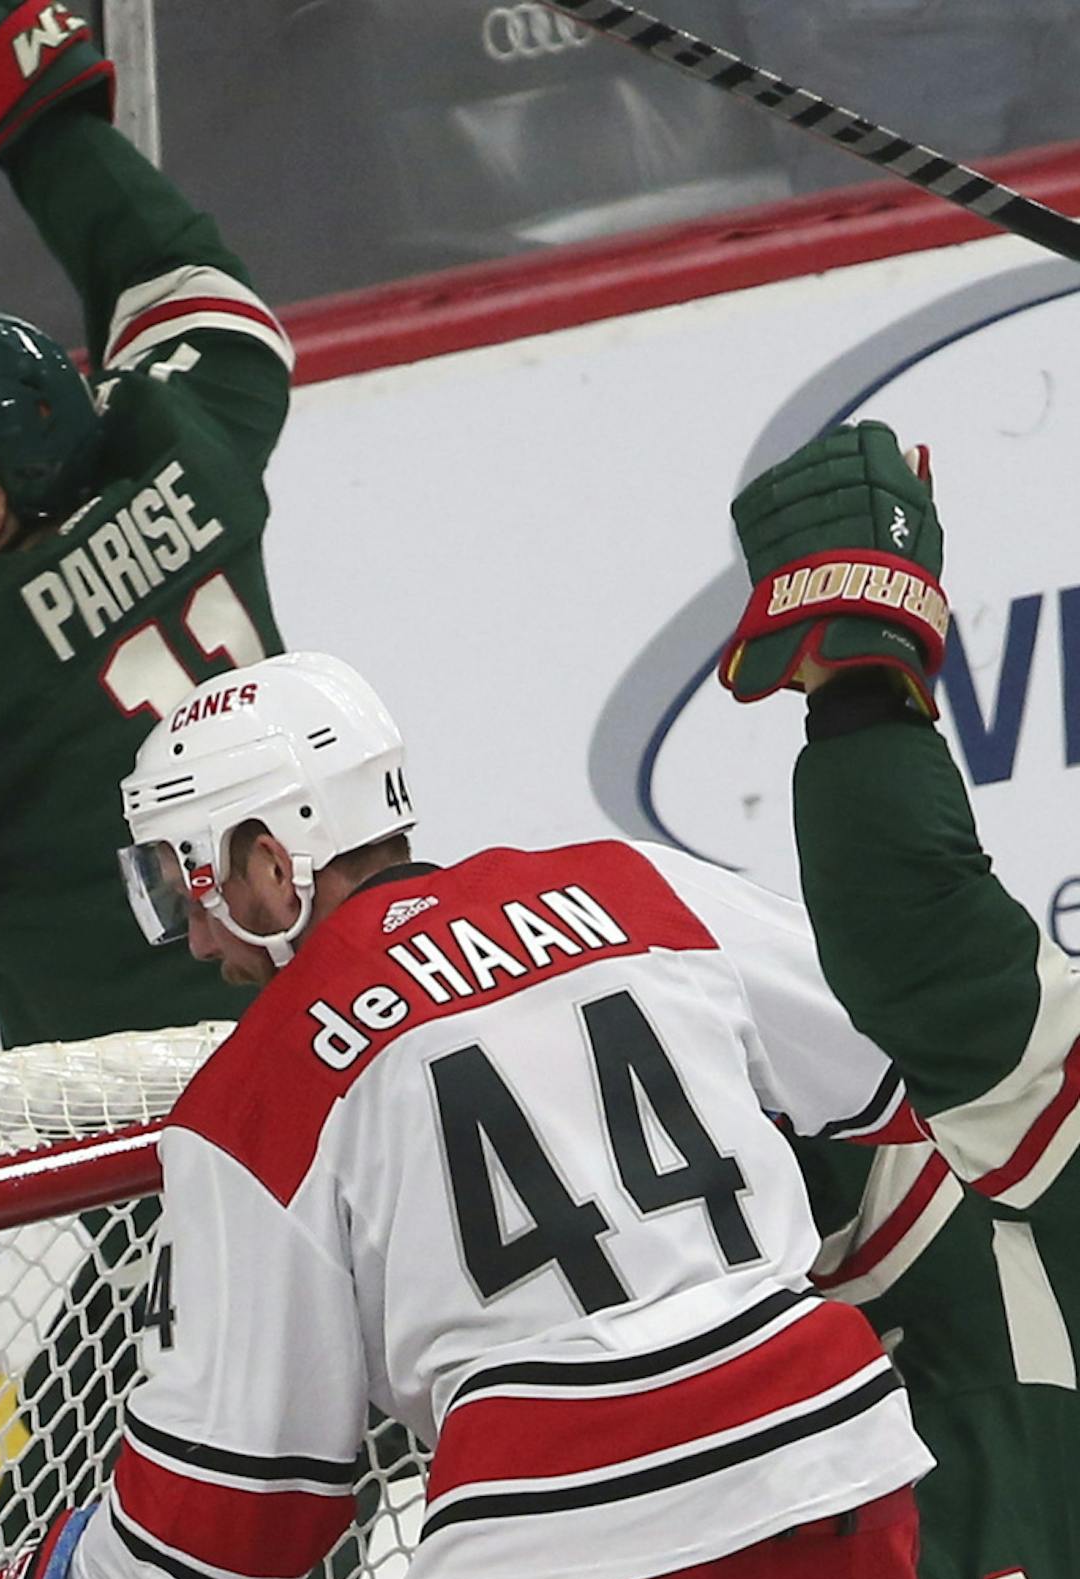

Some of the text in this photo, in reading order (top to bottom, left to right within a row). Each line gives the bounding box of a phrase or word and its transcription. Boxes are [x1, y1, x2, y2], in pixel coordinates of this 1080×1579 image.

[20, 460, 224, 662] PARISE
[171, 683, 258, 733] CANES
[385, 767, 412, 816] 44
[308, 884, 629, 1071] de HAAN
[422, 984, 767, 1317] 44
